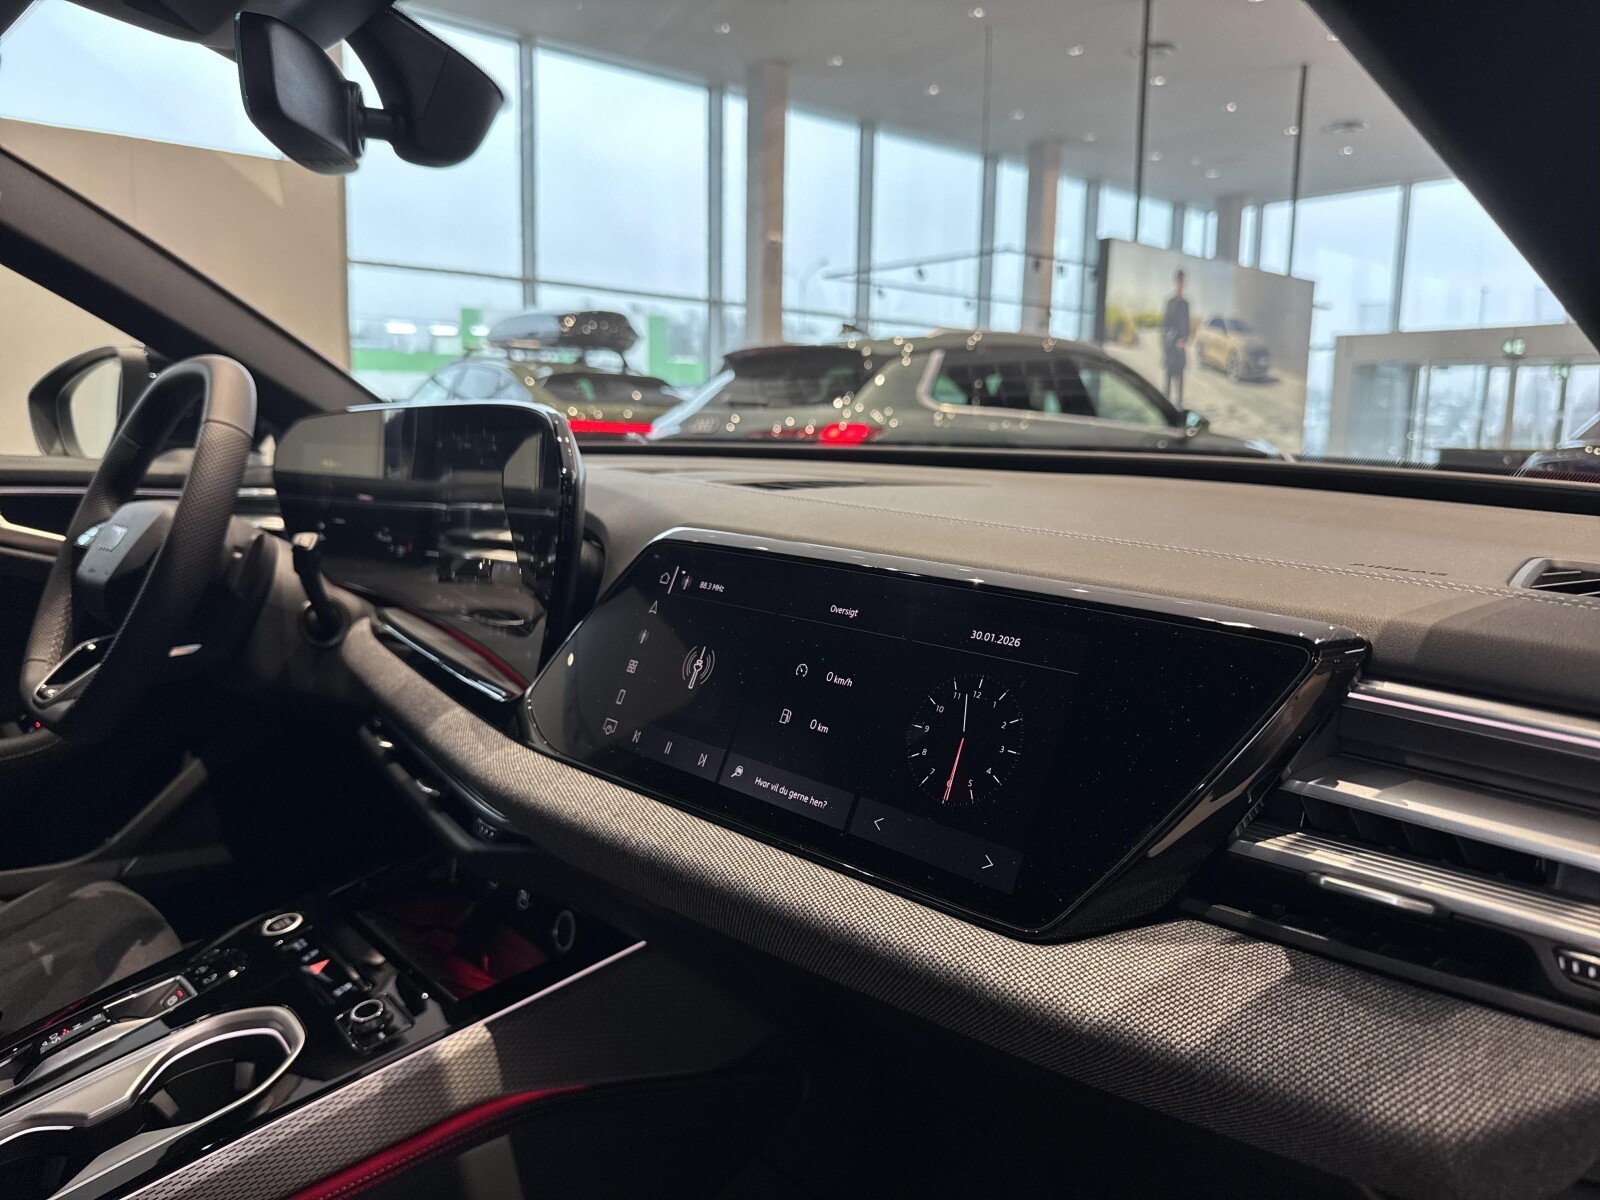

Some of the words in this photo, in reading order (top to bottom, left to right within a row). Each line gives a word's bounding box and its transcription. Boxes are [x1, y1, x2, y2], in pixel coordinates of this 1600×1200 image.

[699, 581, 712, 590] 88.3
[712, 582, 725, 593] MHz
[830, 604, 859, 619] Oversigt
[970, 630, 1022, 648] 30.01.2026
[826, 671, 834, 682] 0
[833, 674, 853, 688] km/h
[953, 692, 962, 700] 11
[973, 690, 982, 699] 12
[935, 705, 945, 713] 10
[992, 701, 997, 709] 1
[809, 719, 818, 730] 0
[817, 723, 829, 734] km
[924, 725, 930, 733] 9
[1001, 721, 1007, 729] 2
[921, 748, 928, 756] 8
[999, 745, 1005, 753] 3
[985, 767, 992, 775] 4
[967, 779, 973, 787] 5
[754, 776, 770, 789] Hvor
[770, 783, 779, 792] vil
[779, 785, 789, 796] du
[788, 790, 809, 803] gerne
[809, 796, 828, 809] hen?
